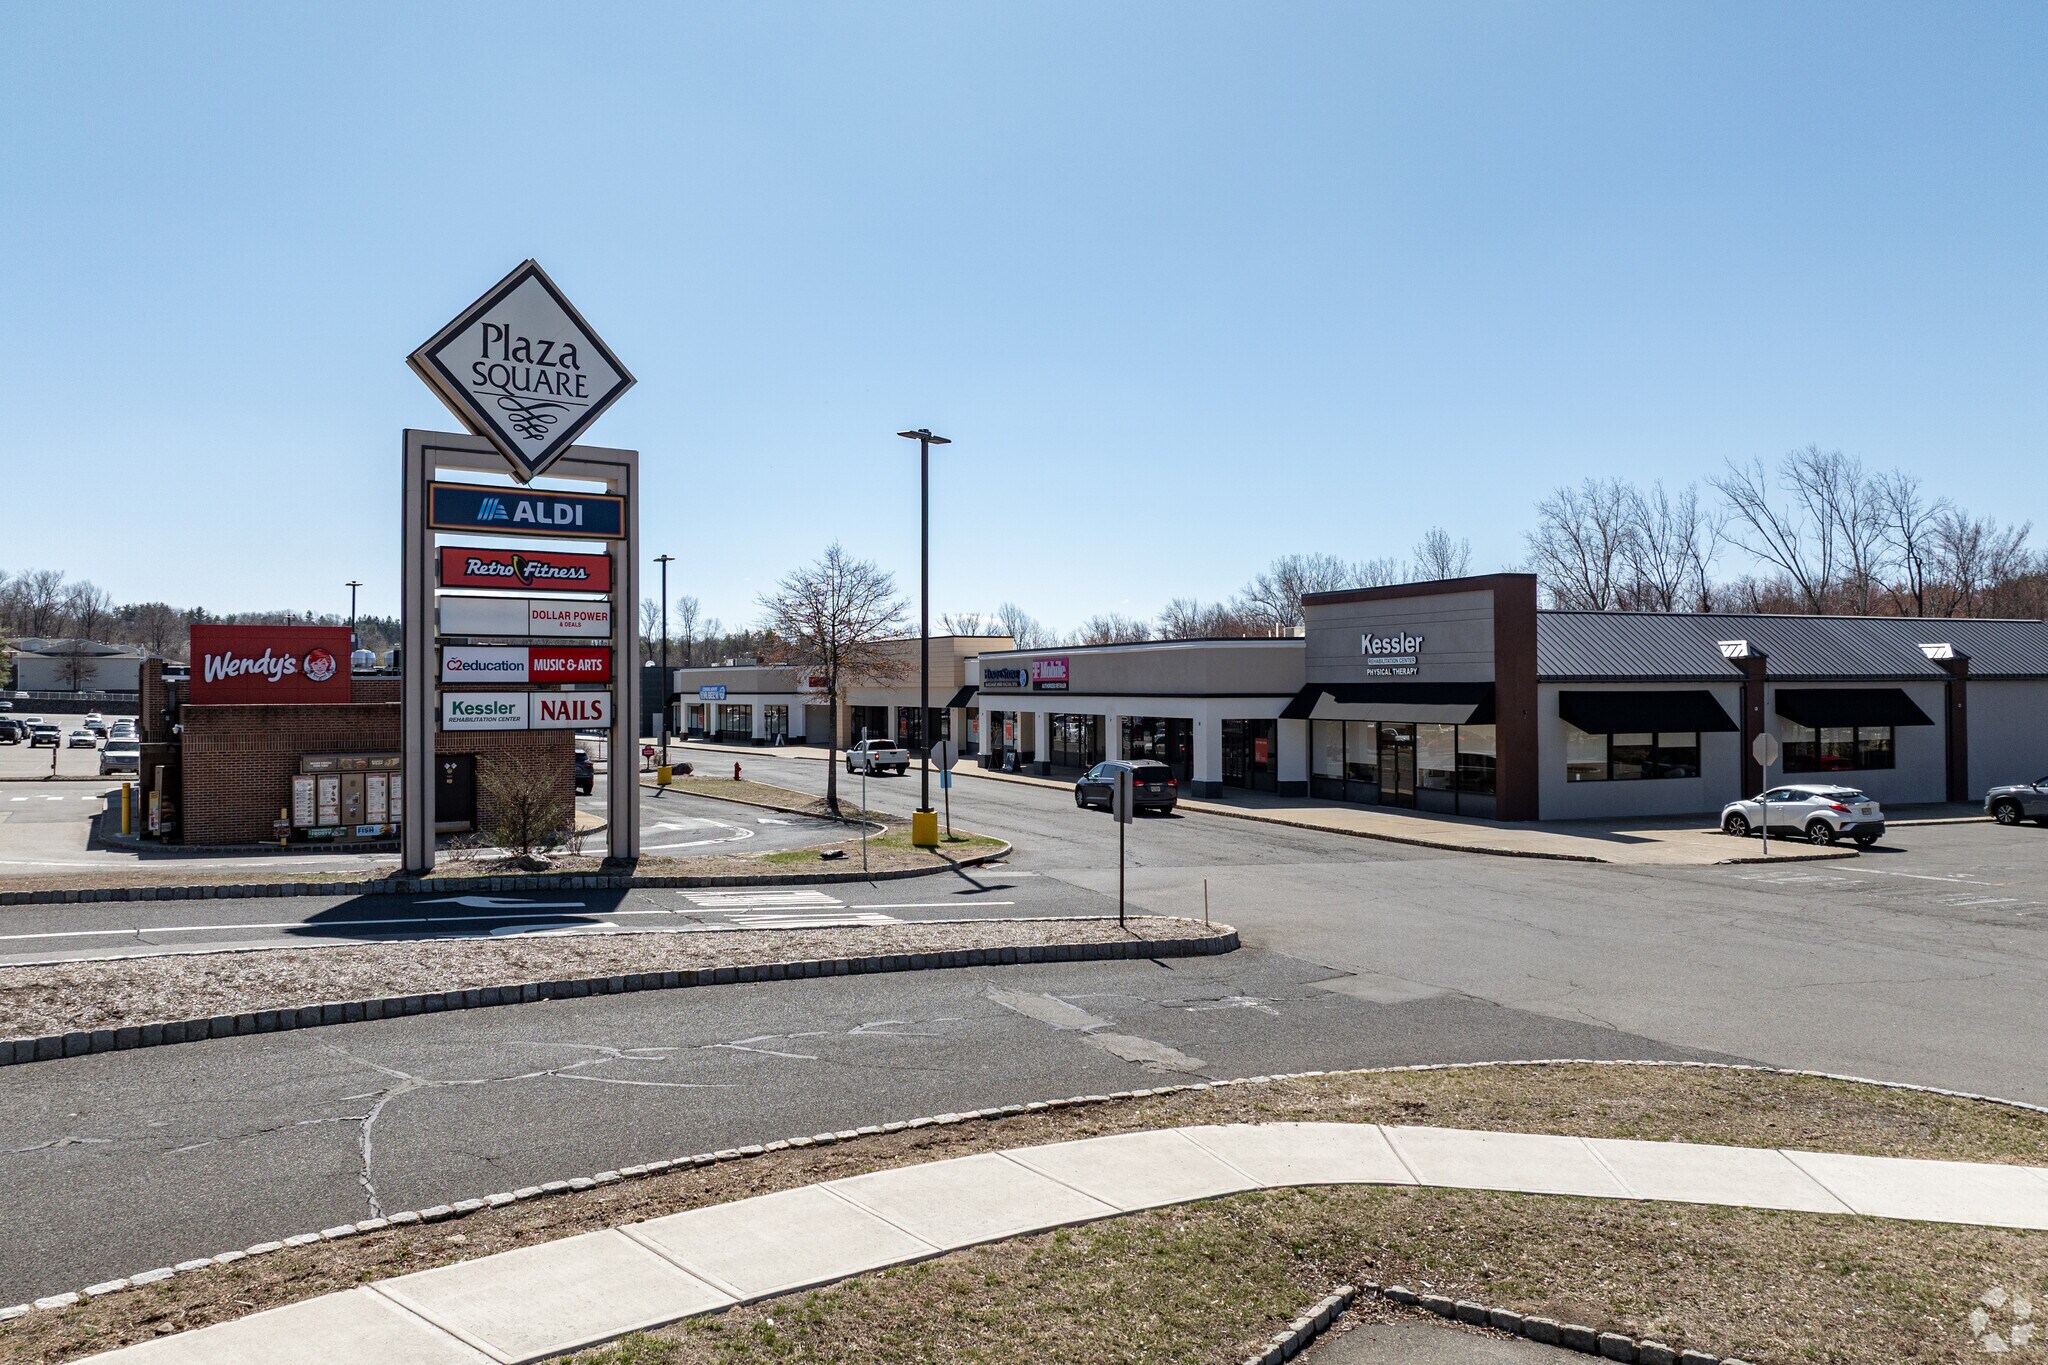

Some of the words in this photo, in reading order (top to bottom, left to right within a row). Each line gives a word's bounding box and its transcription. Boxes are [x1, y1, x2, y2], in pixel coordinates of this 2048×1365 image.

[481, 322, 581, 371] Plaza
[471, 361, 590, 398] SQUARE
[512, 500, 583, 526] ALDI
[465, 558, 515, 576] Retro
[523, 561, 589, 579] Fitness
[532, 610, 571, 621] DOLLAR
[573, 611, 608, 622] POWER
[1361, 632, 1423, 655] Kessler
[204, 647, 297, 683] Wendy's
[533, 658, 565, 671] MUSIC
[566, 659, 577, 671] &
[577, 659, 603, 671] ARTS
[452, 701, 516, 716] Kessler
[541, 700, 603, 721] NAILS
